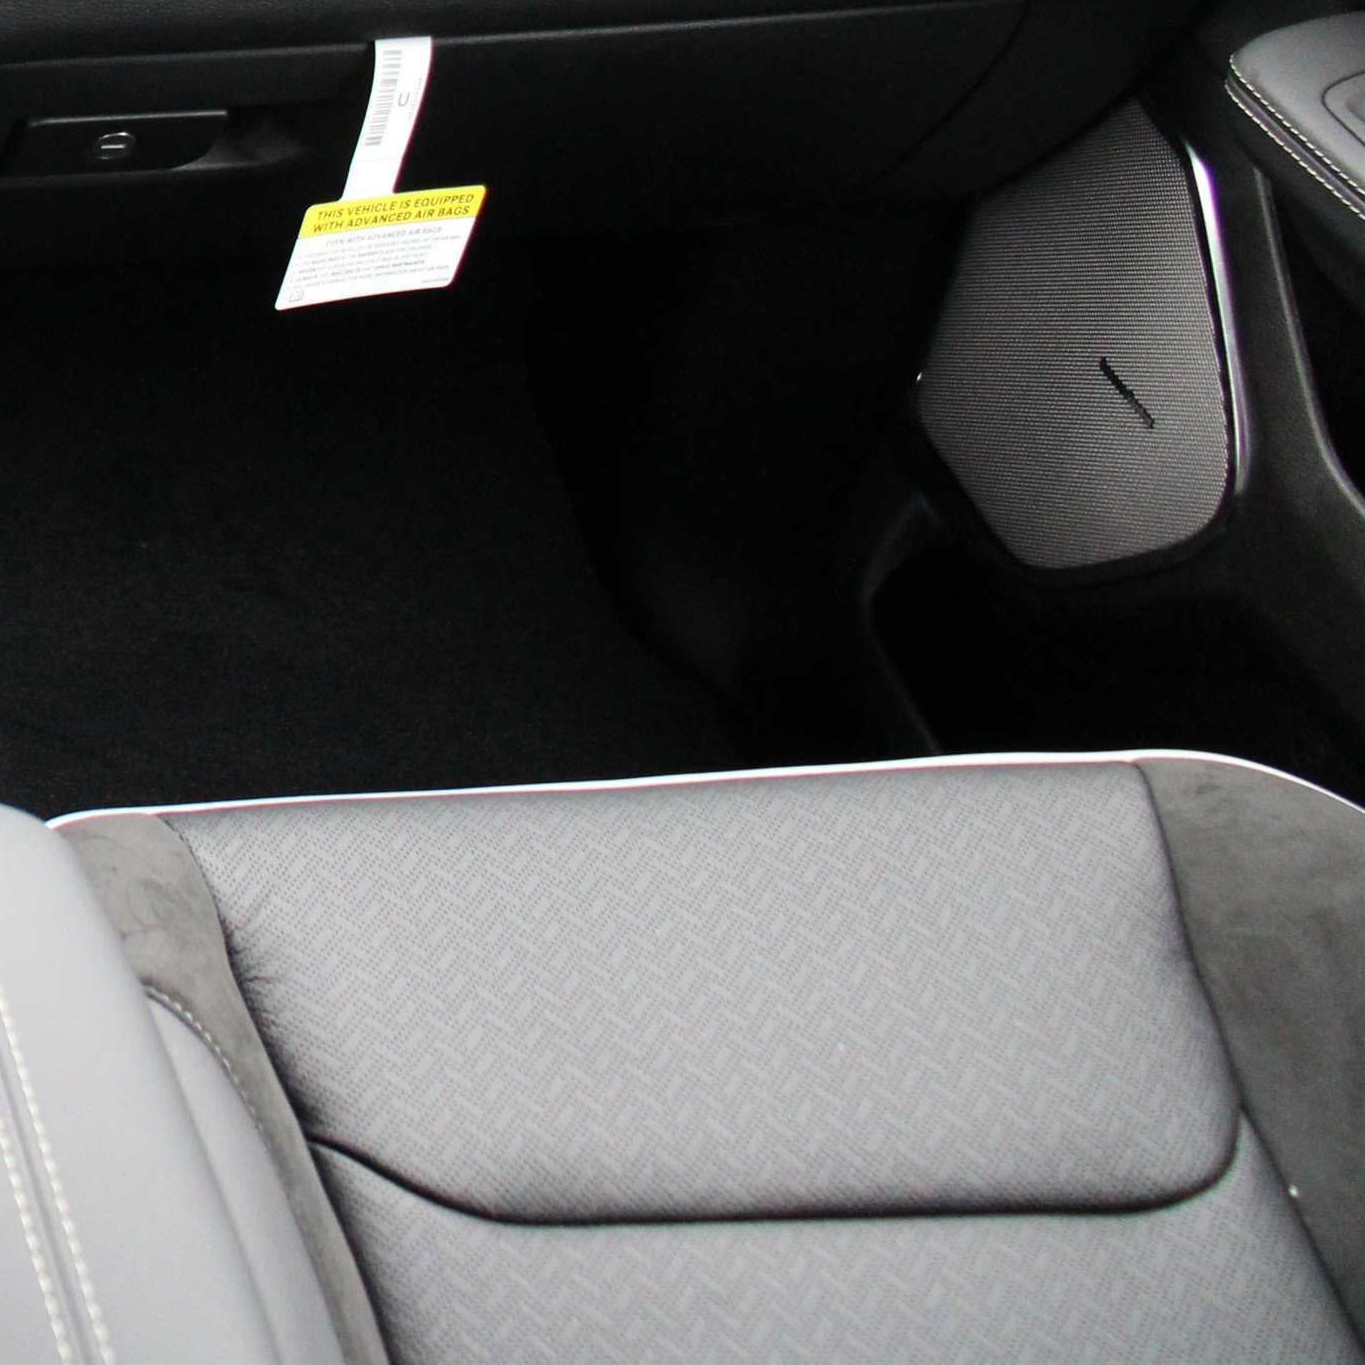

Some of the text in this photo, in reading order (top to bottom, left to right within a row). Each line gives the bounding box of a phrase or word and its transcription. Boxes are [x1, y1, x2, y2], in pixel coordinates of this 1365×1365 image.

[313, 205, 470, 233] WITH ADVANCED AIR BAGS
[318, 193, 475, 220] THIS VEHICLE IS EQUIPPED
